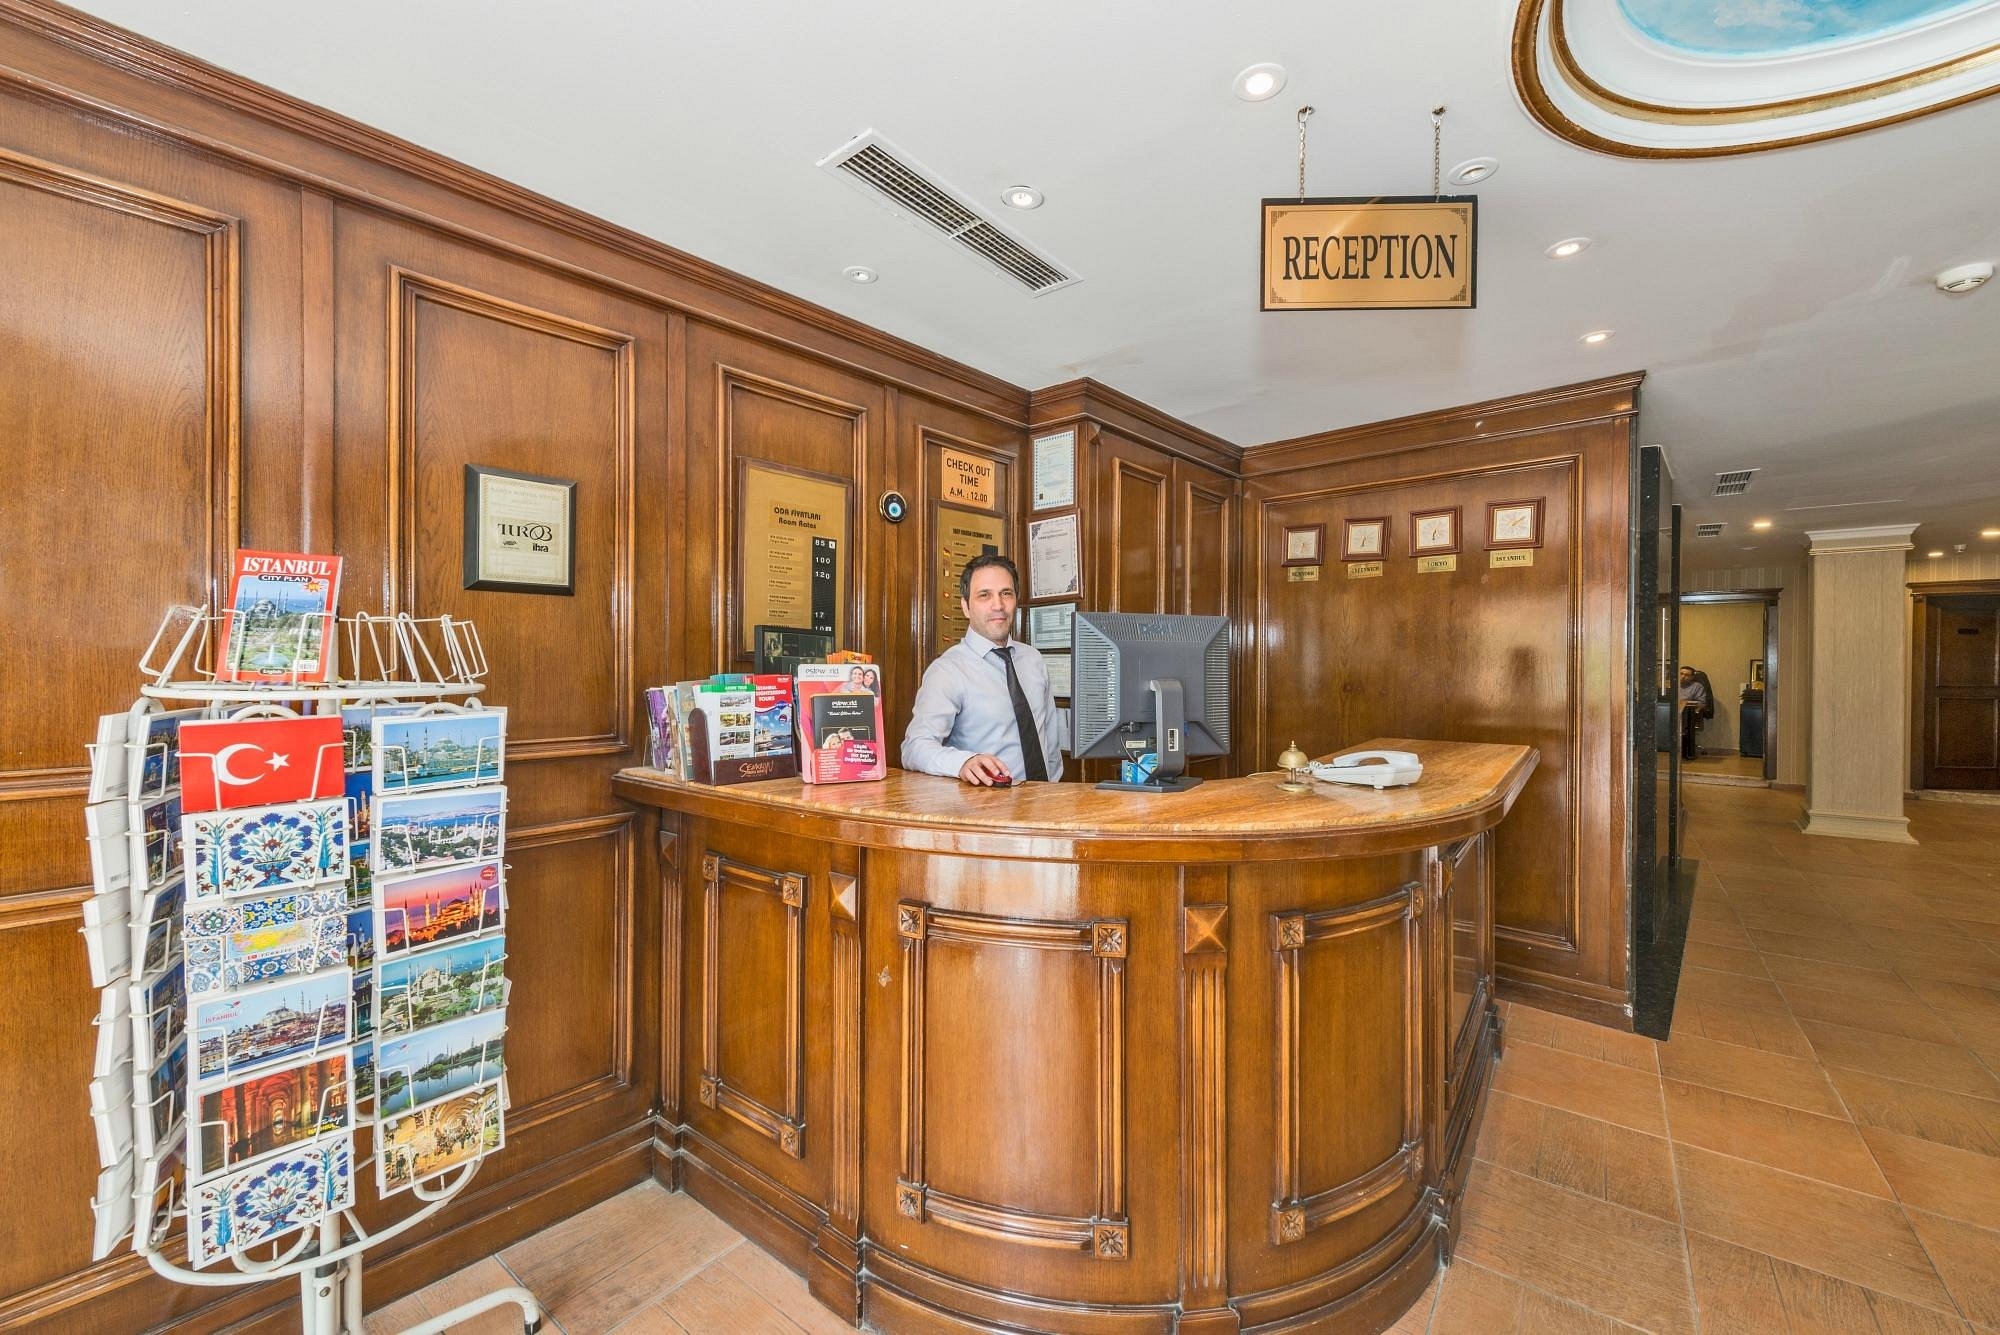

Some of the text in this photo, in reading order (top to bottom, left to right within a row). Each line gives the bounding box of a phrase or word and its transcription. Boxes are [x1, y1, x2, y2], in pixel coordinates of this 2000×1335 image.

[1282, 234, 1458, 281] RECEPTION
[946, 458, 991, 478] CHECK OUT
[959, 474, 979, 488] TIME
[949, 487, 965, 498] A.M.
[970, 492, 988, 503] 12.00
[774, 506, 790, 516] ODA
[778, 517, 817, 529] Room Rates
[532, 543, 549, 553] ihra
[815, 539, 825, 547] 85
[815, 556, 831, 565] 100
[242, 556, 332, 576] ISTANBUL
[283, 575, 309, 583] PLAN
[815, 571, 830, 580] 120
[815, 611, 824, 619] 17
